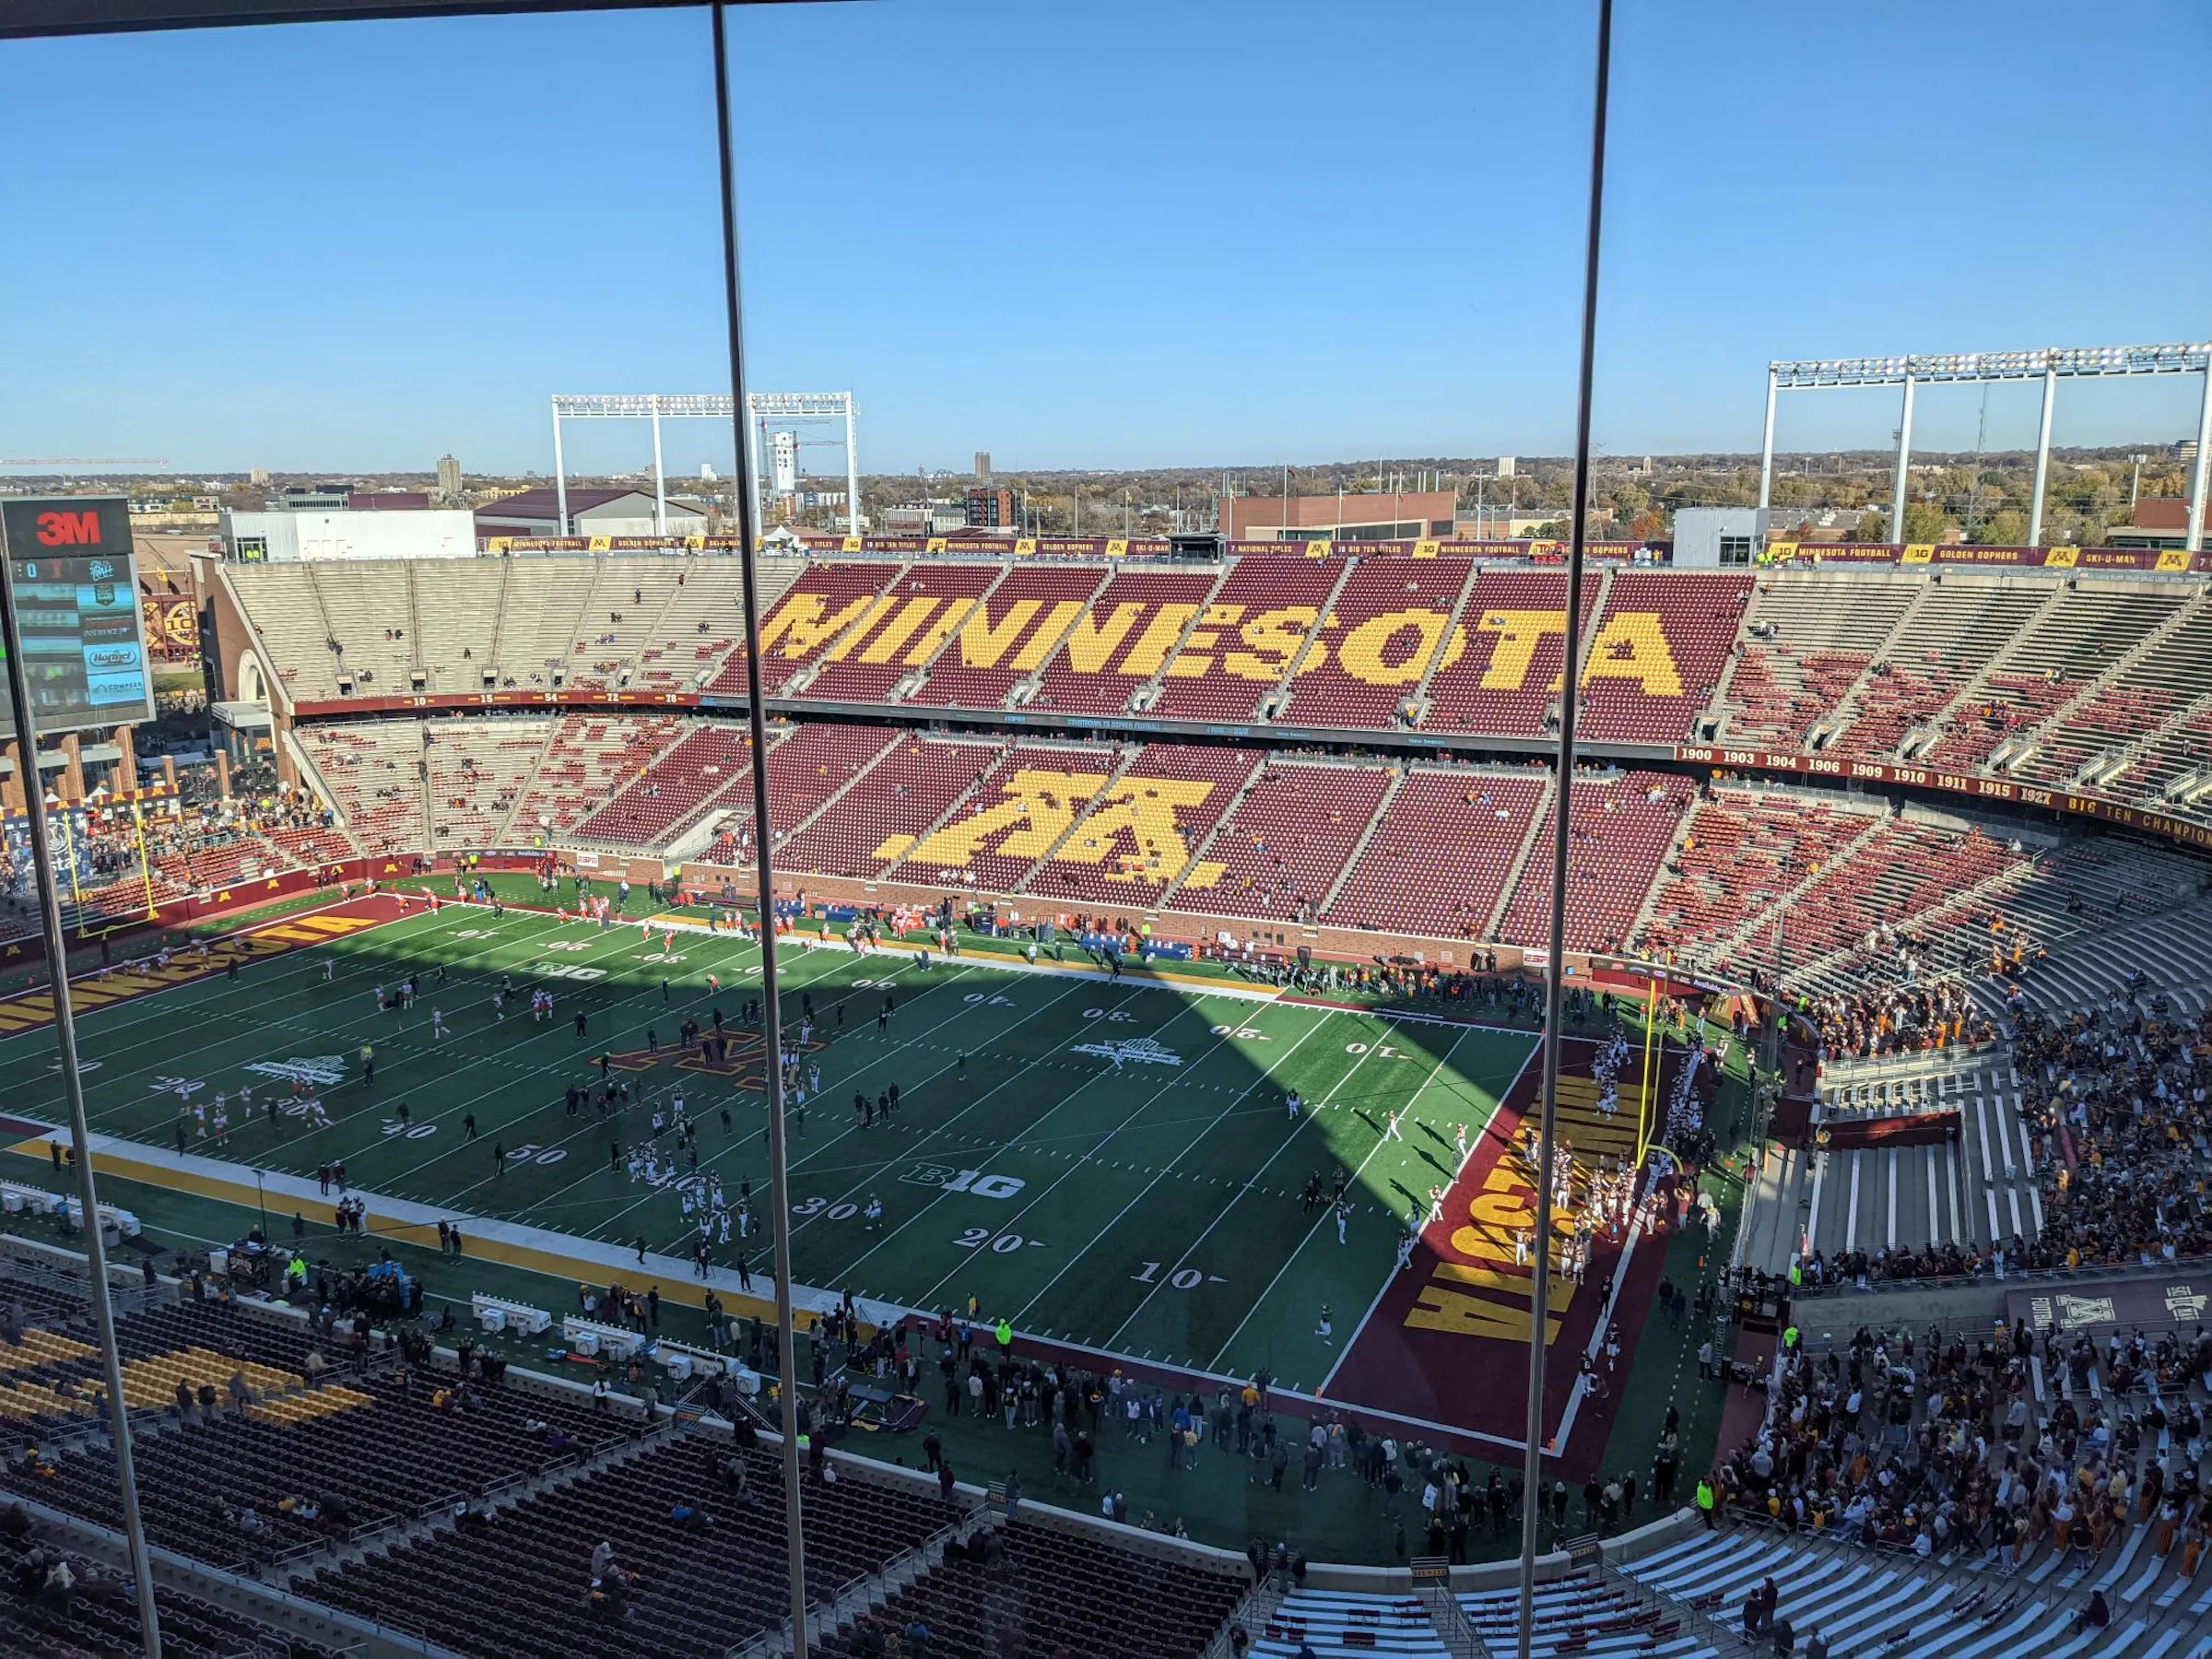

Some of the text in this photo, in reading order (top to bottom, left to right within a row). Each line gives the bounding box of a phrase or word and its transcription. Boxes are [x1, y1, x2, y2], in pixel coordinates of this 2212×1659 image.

[37, 512, 101, 545] 3M
[1238, 545, 1269, 553] NATIONAL
[1271, 545, 1292, 553] TITLES
[1441, 546, 1520, 554] MINNESOTA FOOTBALL
[1593, 546, 1629, 554] GOPHERS
[1798, 547, 1891, 558] MINNESOTA FOOTBALL
[1939, 549, 2018, 560] GOLDEN GOPHERS
[2053, 551, 2070, 562] M
[2163, 555, 2183, 566] M
[2200, 558, 2206, 567] 7
[741, 593, 1683, 697] MINNESOTA
[413, 697, 426, 706] 10
[480, 694, 493, 703] 15
[545, 693, 558, 701] 54
[606, 693, 619, 701] 72
[665, 693, 677, 702] 78
[1681, 747, 2052, 806] 1900 1903 1904 1906 1909 1910 1911 1915 1927
[2068, 796, 2097, 814] BIG
[2106, 806, 2132, 822] TEN
[871, 769, 1229, 889] M
[1524, 953, 1550, 963] ESP
[0, 916, 379, 1030] INNESOTA
[1082, 1008, 1131, 1021] 30
[1209, 1025, 1262, 1039] 20
[1346, 1042, 1399, 1058] 10
[505, 1145, 568, 1165] 50
[792, 1197, 858, 1221] 30
[952, 1228, 1024, 1253] 20
[1130, 1261, 1203, 1289] 10
[2056, 1294, 2116, 1330] M
